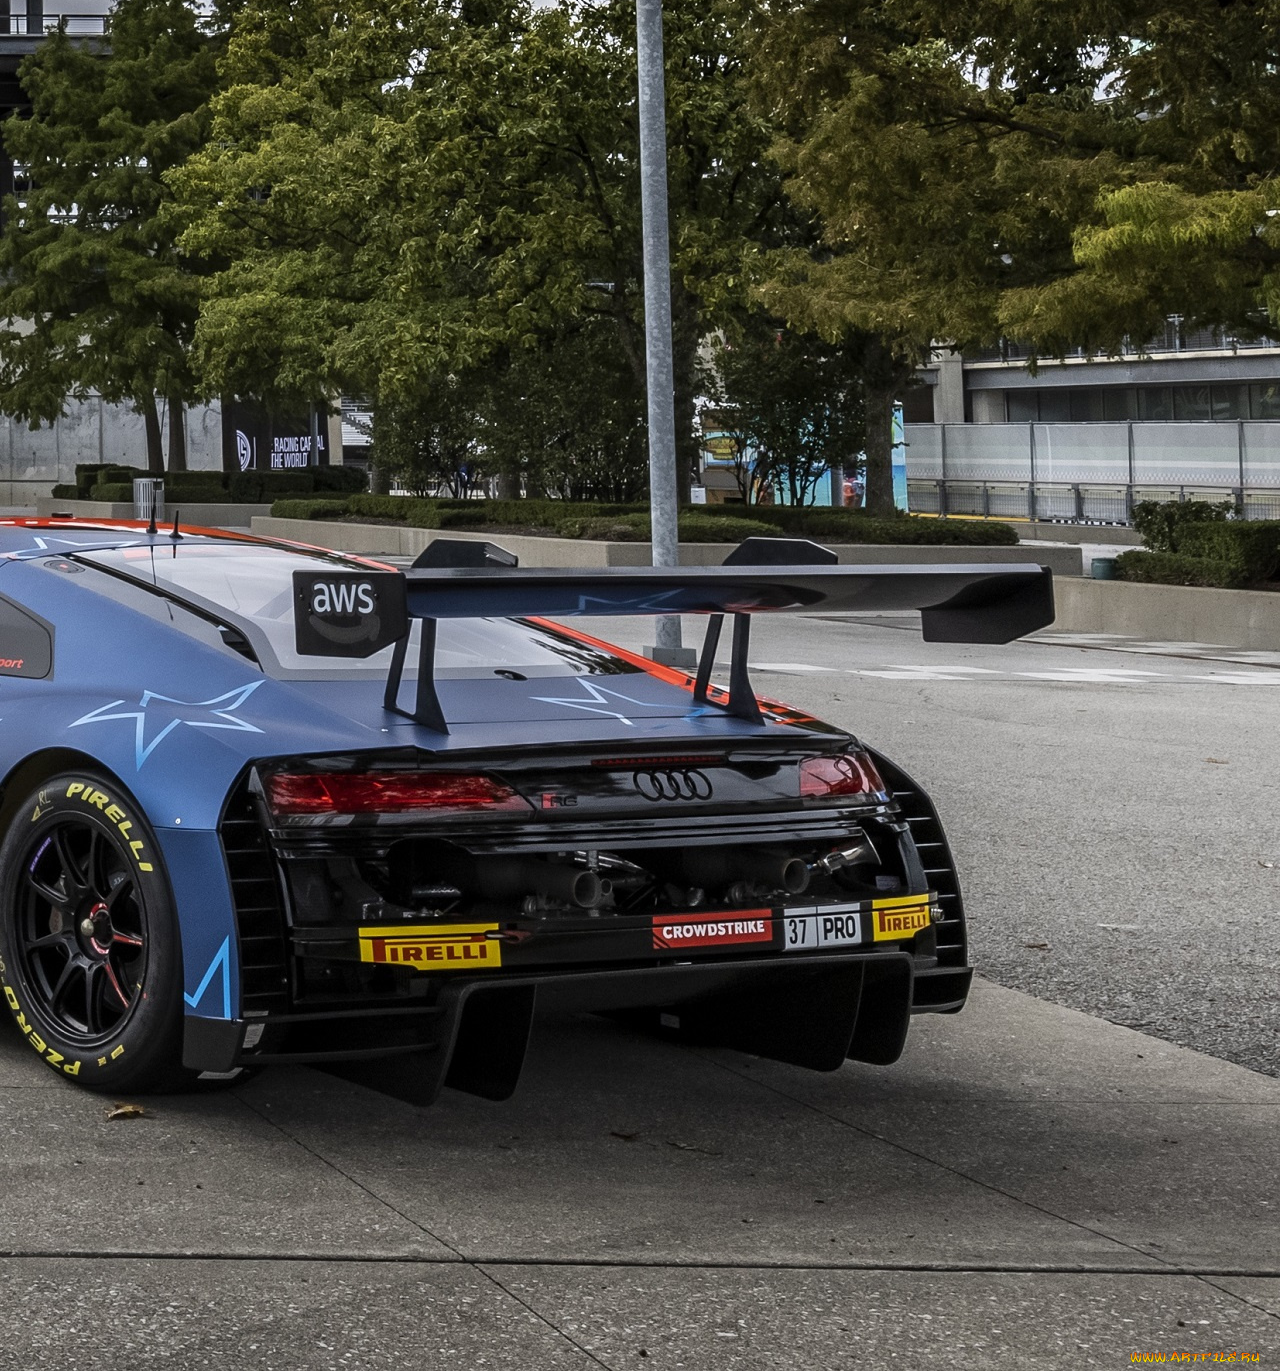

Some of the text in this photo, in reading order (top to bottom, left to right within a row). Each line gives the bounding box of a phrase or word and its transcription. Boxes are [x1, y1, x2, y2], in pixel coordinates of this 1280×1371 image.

[274, 436, 299, 453] RACING
[283, 452, 308, 468] WORLD
[313, 582, 374, 614] aws
[65, 782, 154, 872] PIRELLI
[662, 920, 765, 939] CROWDSTRIKE
[788, 915, 856, 944] 37 PRO
[878, 906, 927, 933] PIRELLI
[371, 934, 488, 963] PIRELLI
